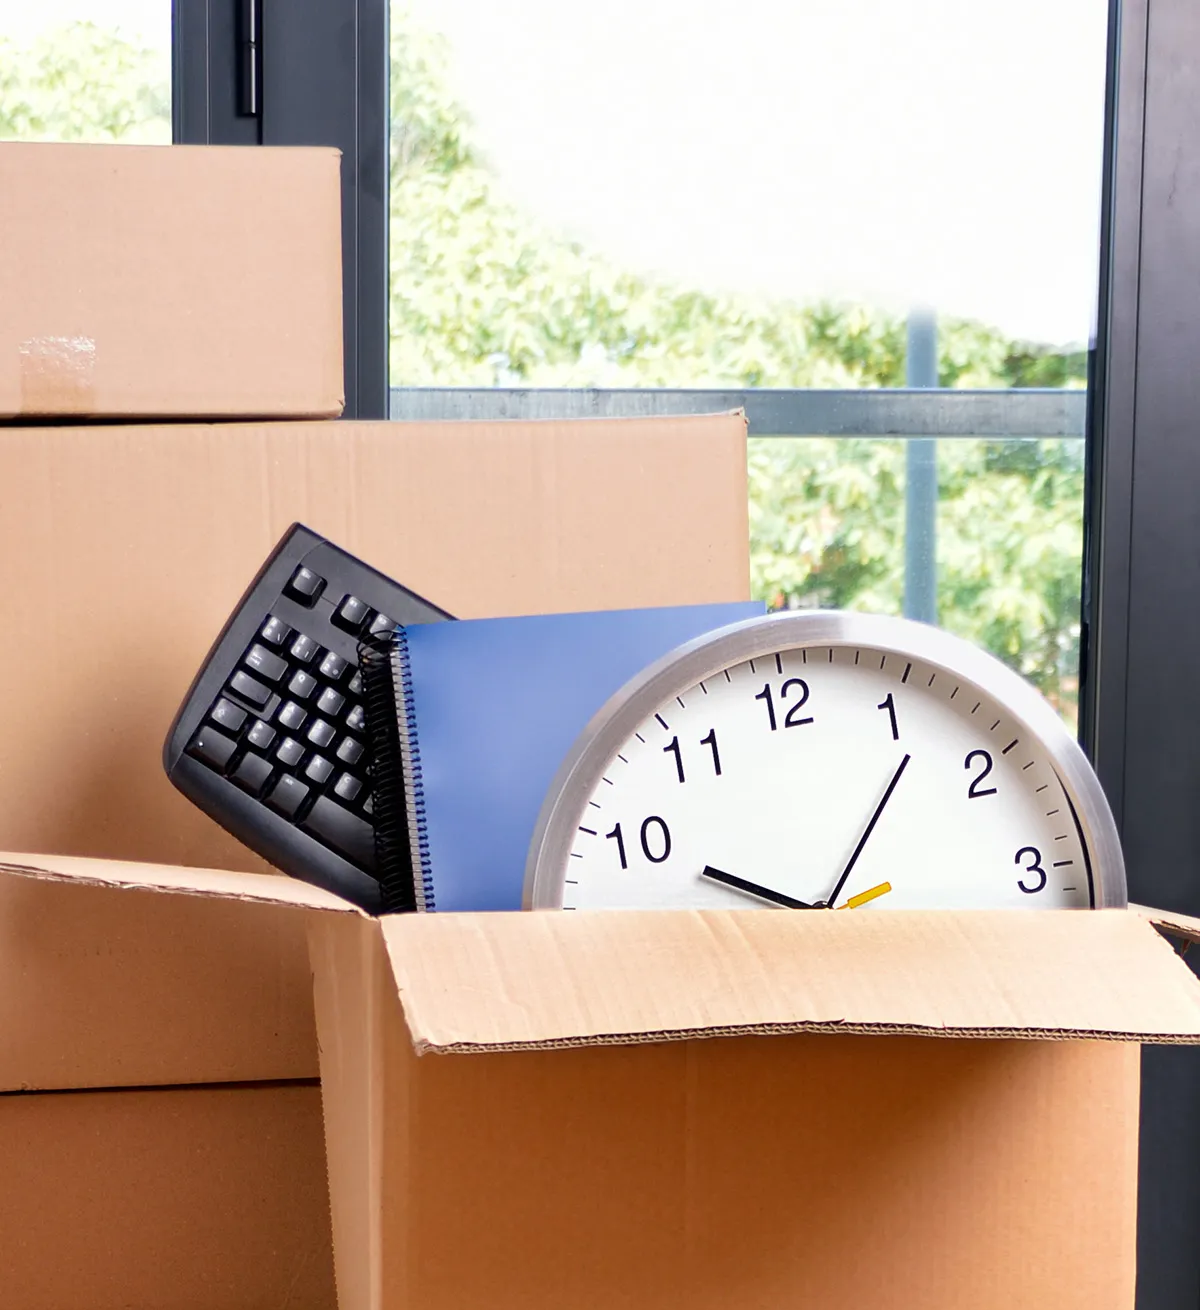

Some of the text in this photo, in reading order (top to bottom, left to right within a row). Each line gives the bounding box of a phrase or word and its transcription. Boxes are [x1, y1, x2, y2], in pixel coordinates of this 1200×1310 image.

[754, 677, 815, 732] 12
[876, 691, 900, 742] 1
[663, 727, 723, 784] 11
[963, 749, 999, 800] 2
[604, 814, 673, 871] 10
[1013, 845, 1048, 895] 3
